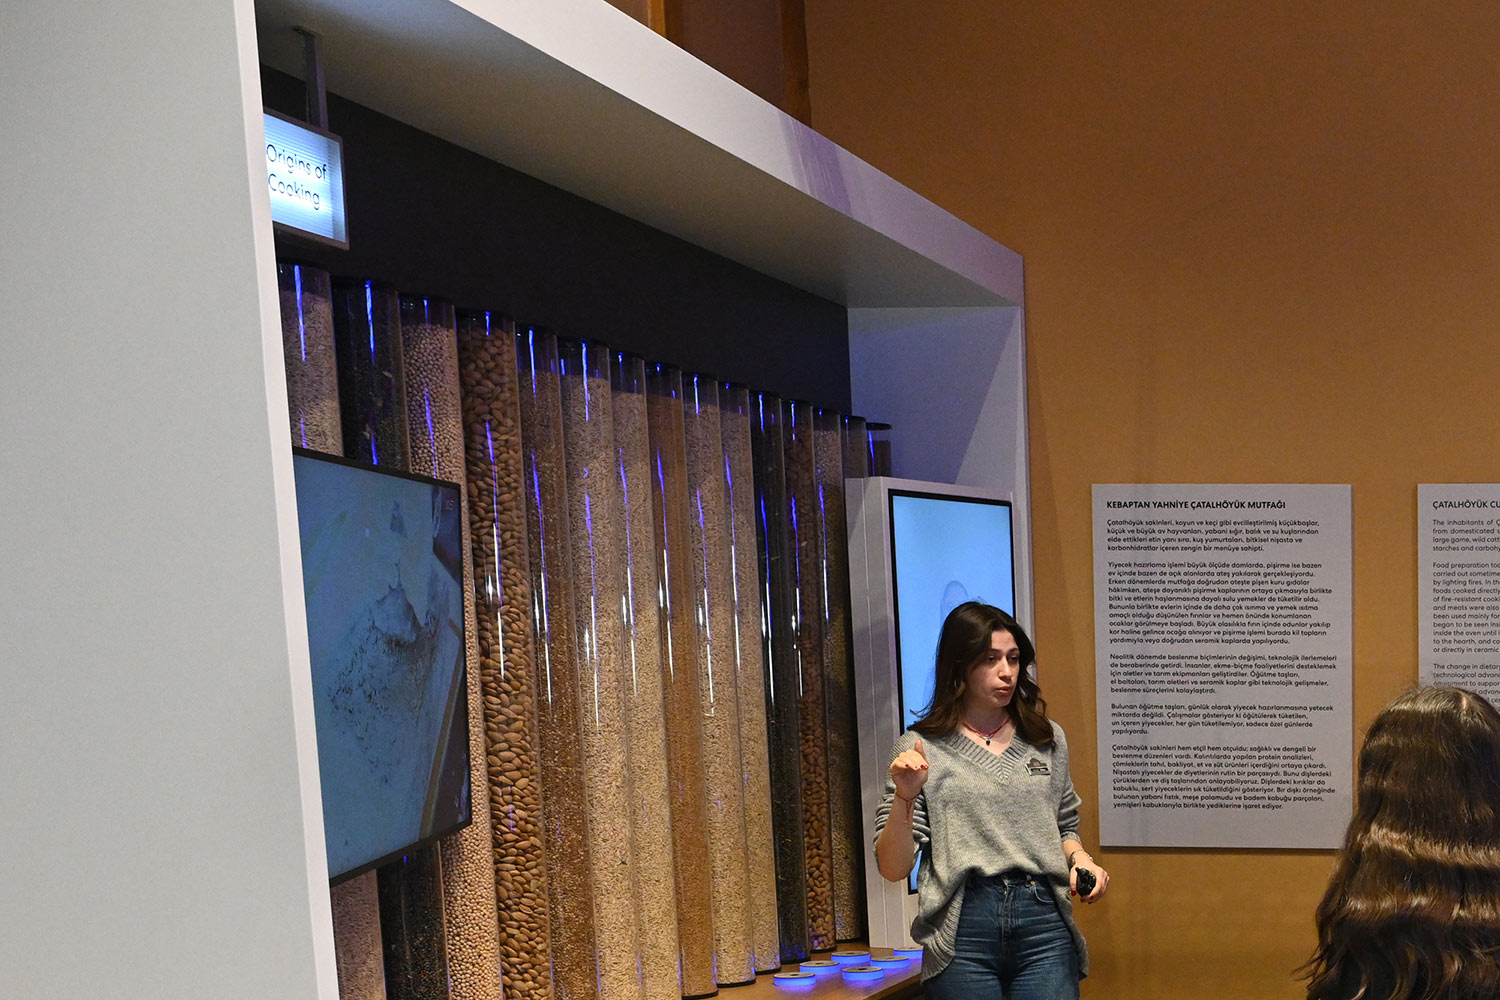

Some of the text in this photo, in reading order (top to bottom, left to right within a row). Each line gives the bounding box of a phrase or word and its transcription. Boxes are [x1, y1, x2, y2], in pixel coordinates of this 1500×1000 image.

[266, 144, 327, 181] Origins of
[268, 173, 320, 210] Cooking
[1153, 500, 1188, 508] YAHNİYE
[1191, 500, 1246, 510] ÇATALHÖYÜK
[1248, 500, 1286, 508] MUTFAĞI
[1433, 500, 1488, 510] ÇATALHÖYÜK
